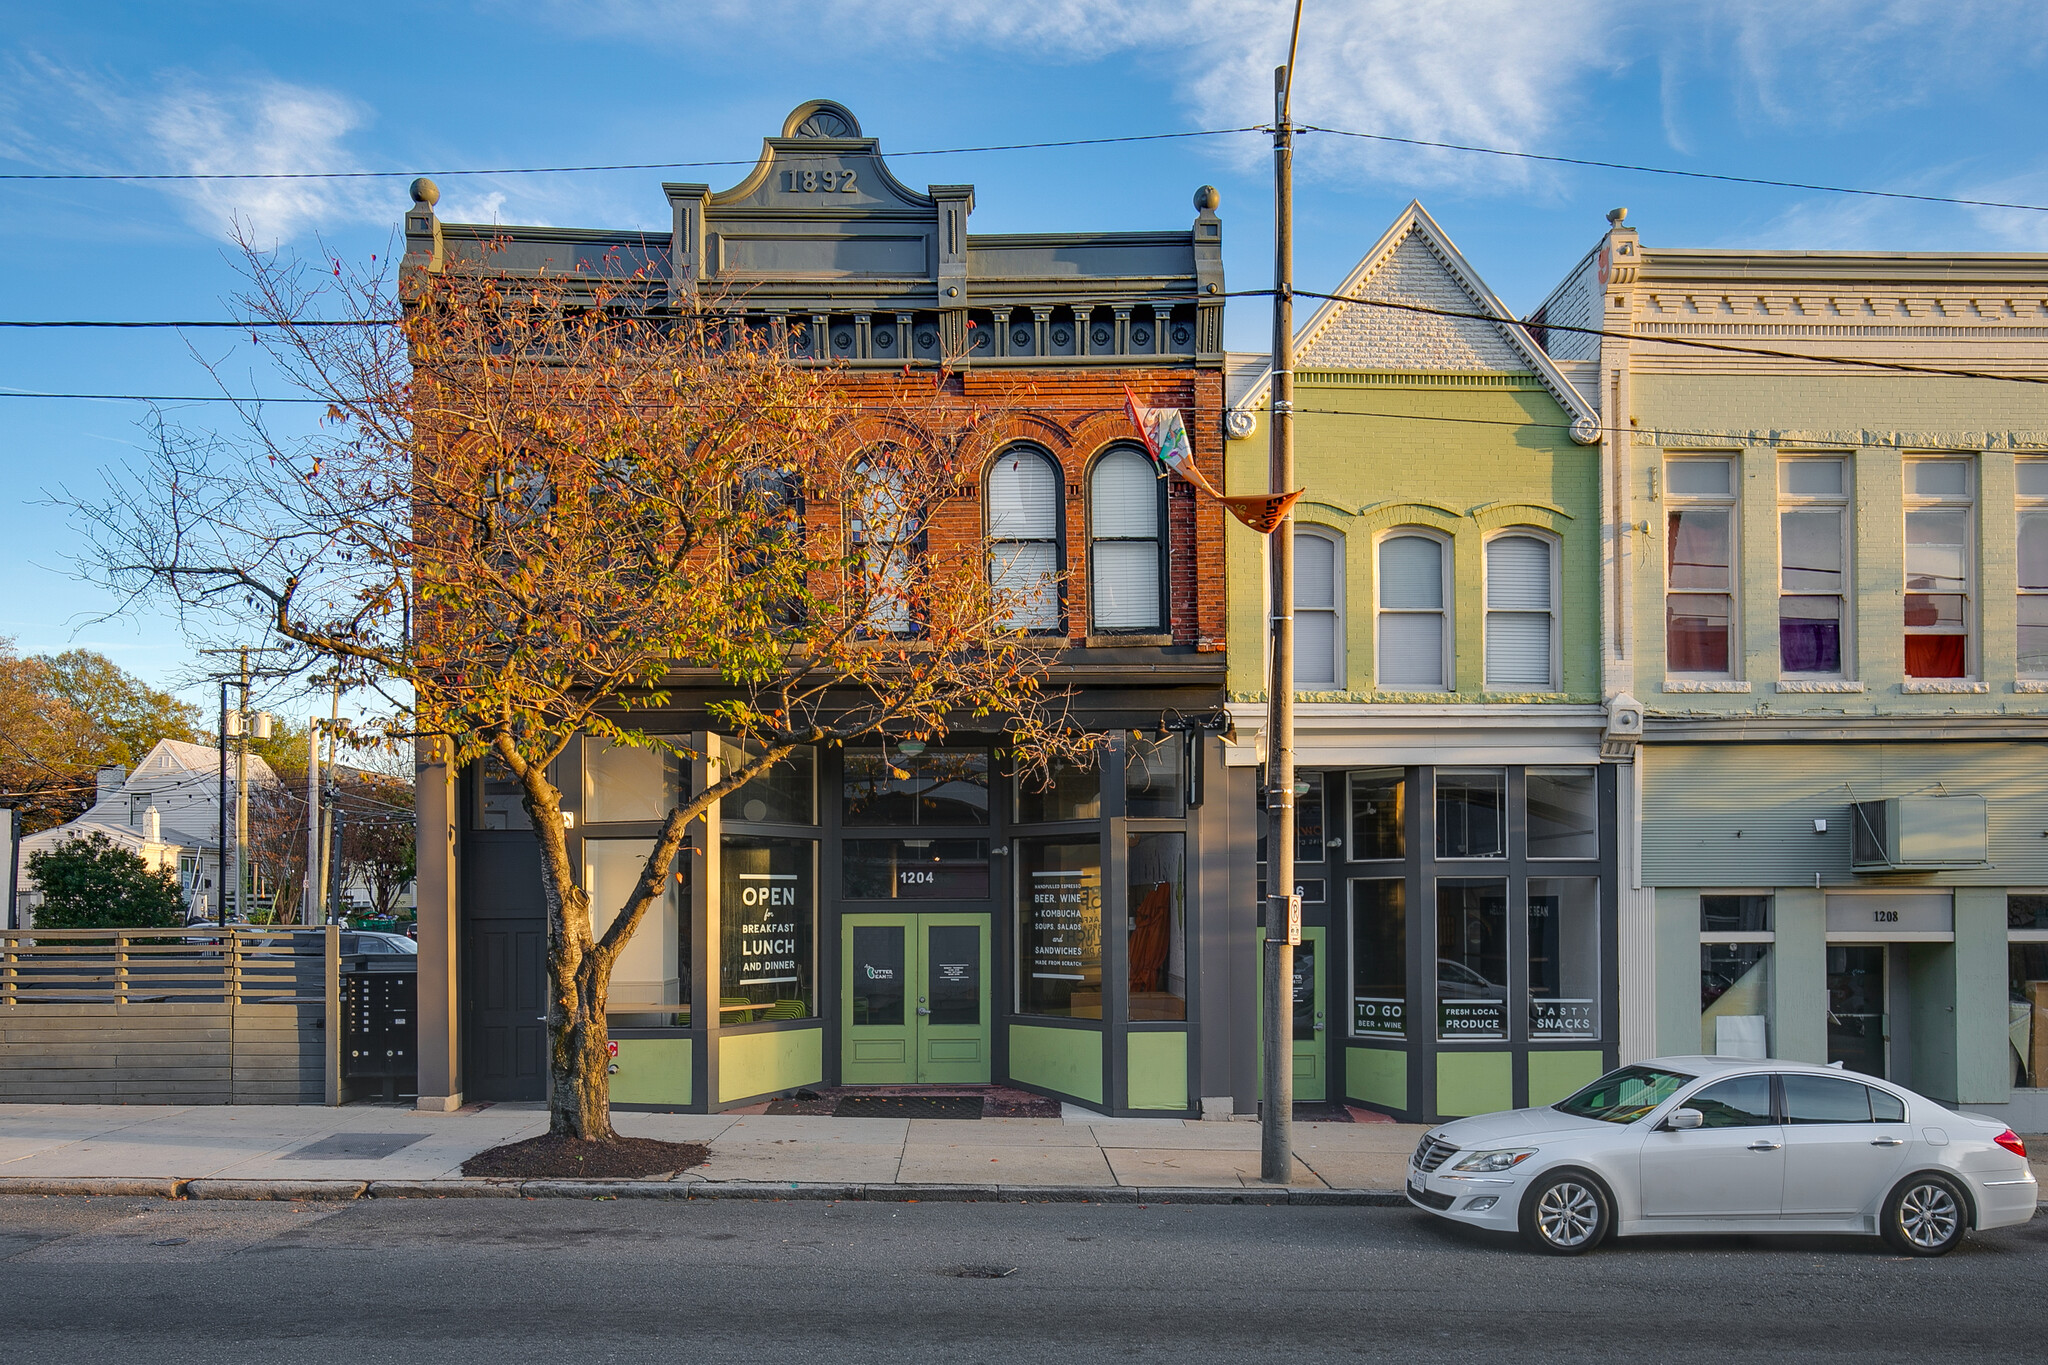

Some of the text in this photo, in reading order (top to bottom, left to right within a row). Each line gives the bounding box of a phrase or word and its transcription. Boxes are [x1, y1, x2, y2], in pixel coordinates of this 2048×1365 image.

[789, 168, 858, 193] 1892
[1260, 496, 1284, 529] Enjoy
[900, 871, 934, 884] 1204
[742, 886, 795, 906] OPEN
[1060, 894, 1081, 903] WINE
[763, 907, 774, 921] for
[1040, 909, 1081, 918] KOMBUCHA
[1873, 910, 1899, 922] 1208
[742, 923, 795, 934] BREAKFAST
[1052, 934, 1063, 942] and
[742, 939, 795, 956] LUNCH
[1034, 946, 1082, 955] SANDWICHES
[743, 960, 795, 972] AND DINNER
[1358, 1004, 1402, 1018] TO GO
[1446, 1008, 1500, 1016] FRESH LOCAL
[1536, 1007, 1590, 1016] TASTY
[1358, 1020, 1375, 1028] BEER
[1384, 1021, 1402, 1030] WINE
[1446, 1019, 1500, 1029] PRODUCE
[1536, 1018, 1590, 1029] SNACKS
